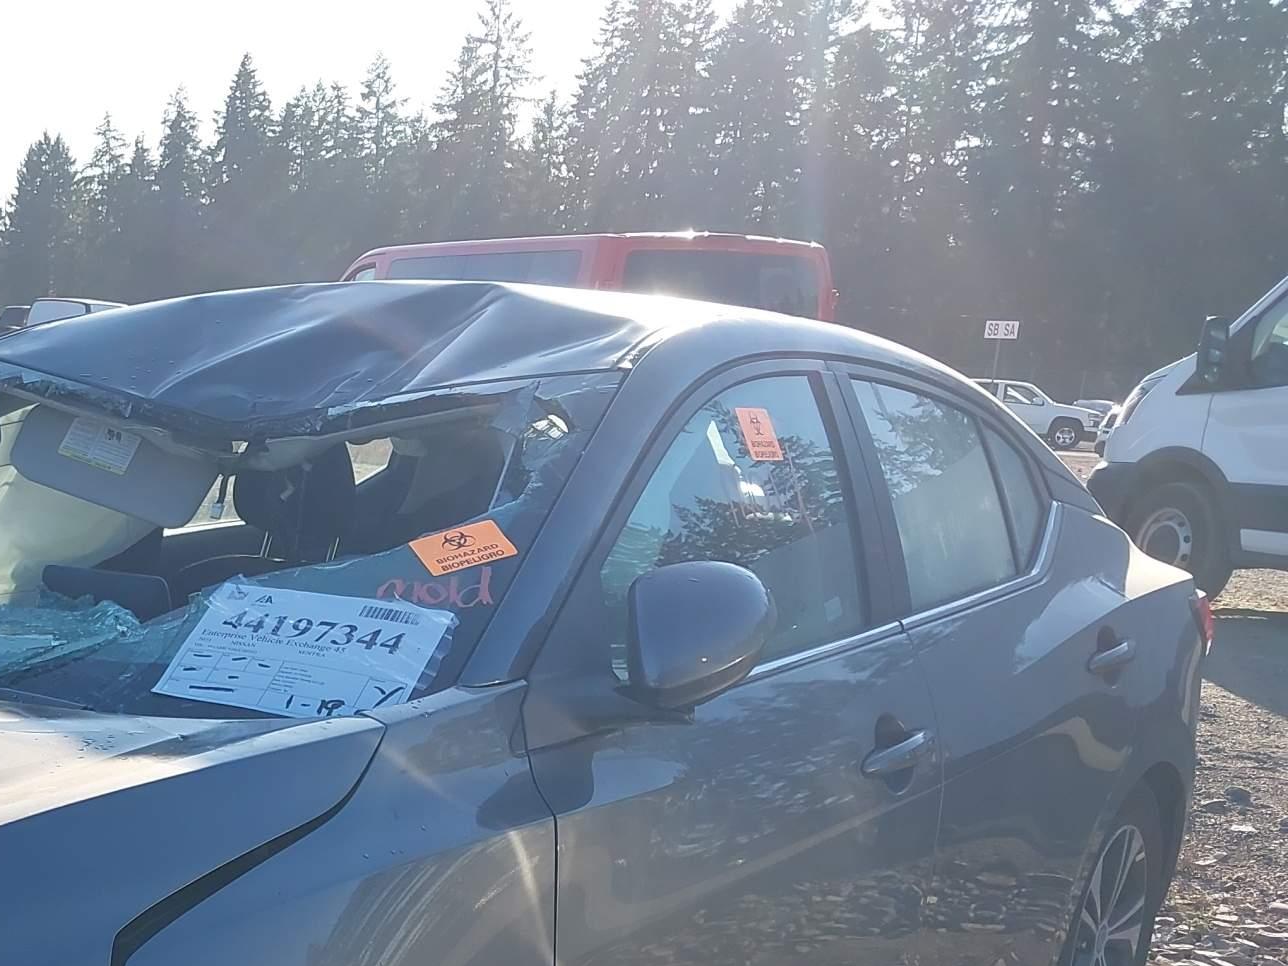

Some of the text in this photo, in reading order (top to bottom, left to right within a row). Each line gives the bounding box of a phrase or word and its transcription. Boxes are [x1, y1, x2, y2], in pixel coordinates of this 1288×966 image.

[987, 322, 1016, 337] SB SA
[435, 543, 499, 565] BIOHAZARD
[440, 549, 505, 572] BIOPELIGRO
[201, 628, 247, 641] Enterprise
[250, 633, 284, 645] Vehicle
[285, 639, 332, 652] Exchange
[222, 610, 406, 655] 44197344
